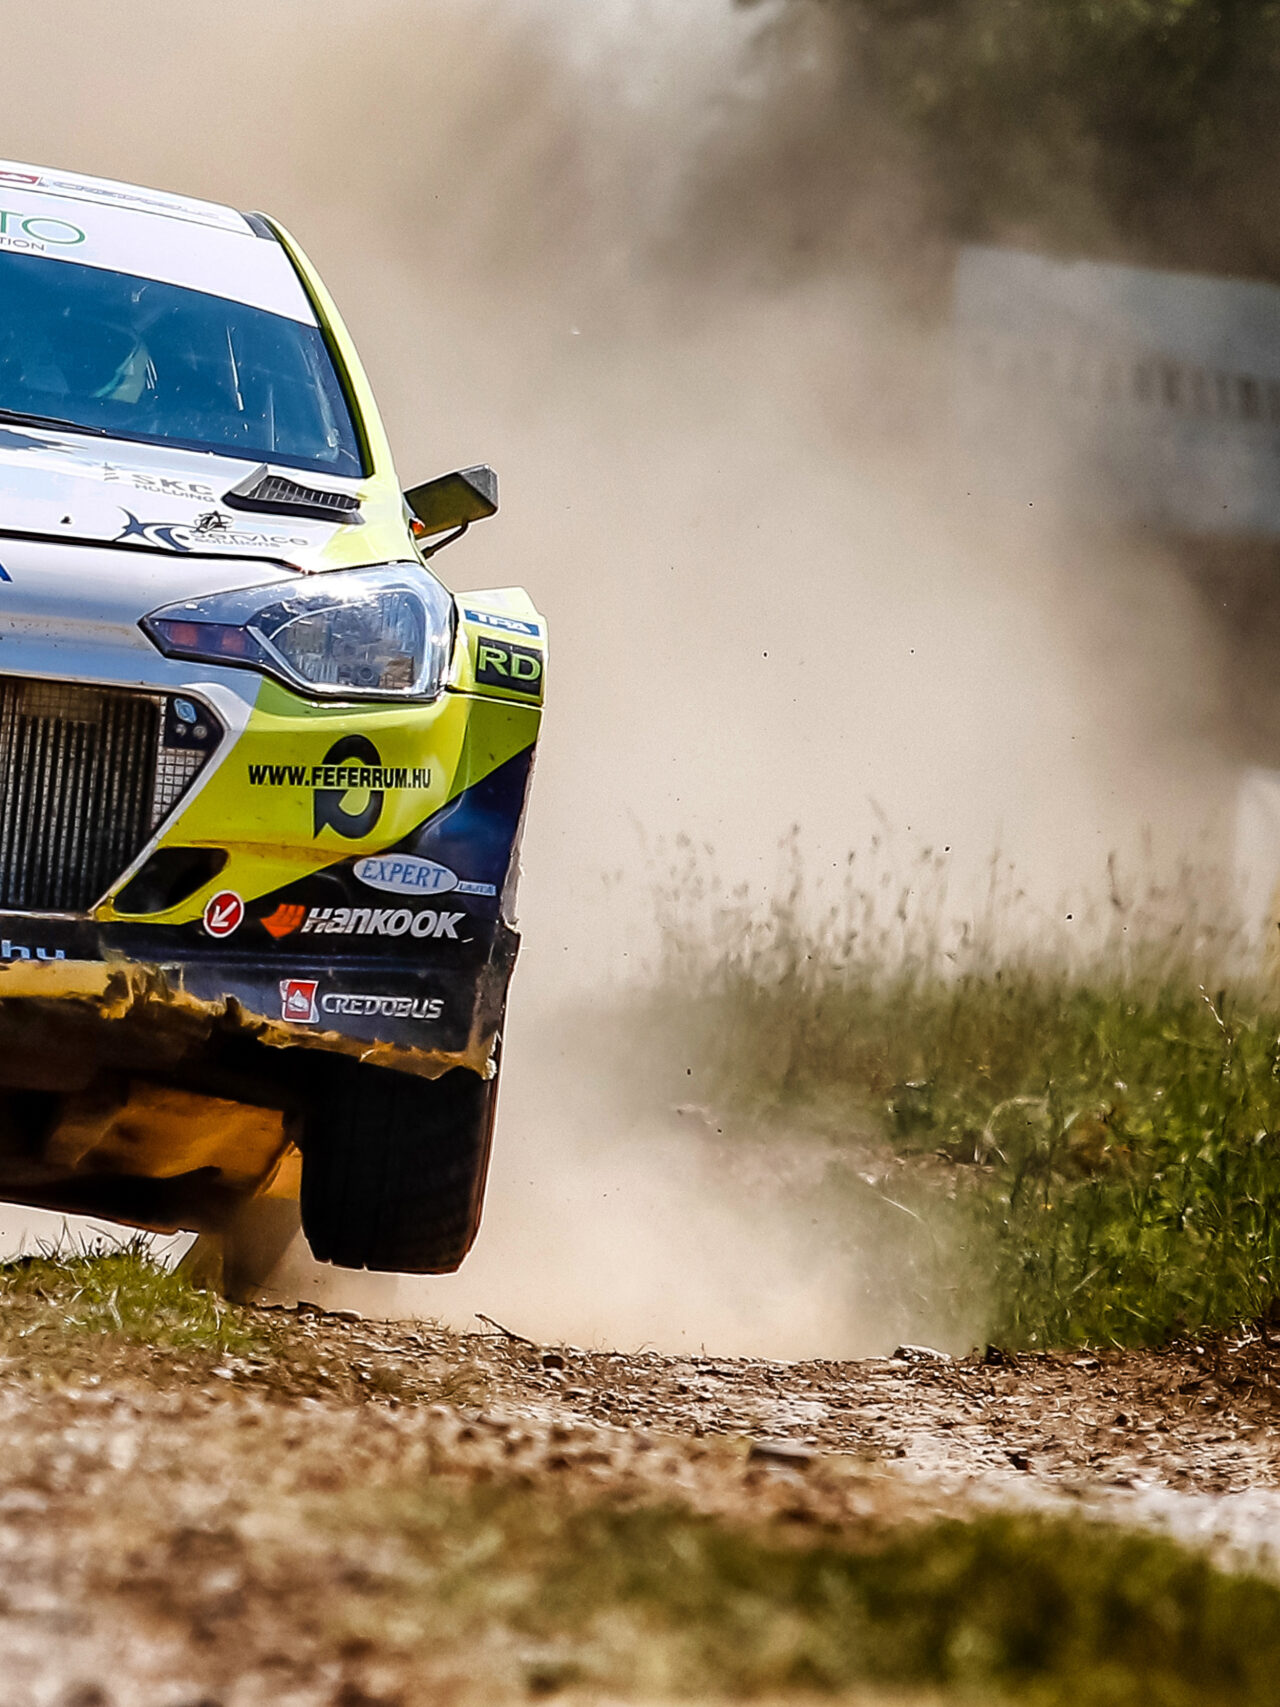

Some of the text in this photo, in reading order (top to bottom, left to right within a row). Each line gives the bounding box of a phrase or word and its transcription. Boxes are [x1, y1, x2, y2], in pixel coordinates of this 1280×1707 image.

[132, 473, 213, 496] SKC
[248, 764, 431, 789] WWW.FEFERRUM.HU
[361, 859, 447, 888] EXPERT
[321, 994, 445, 1020] CREDOBUS
